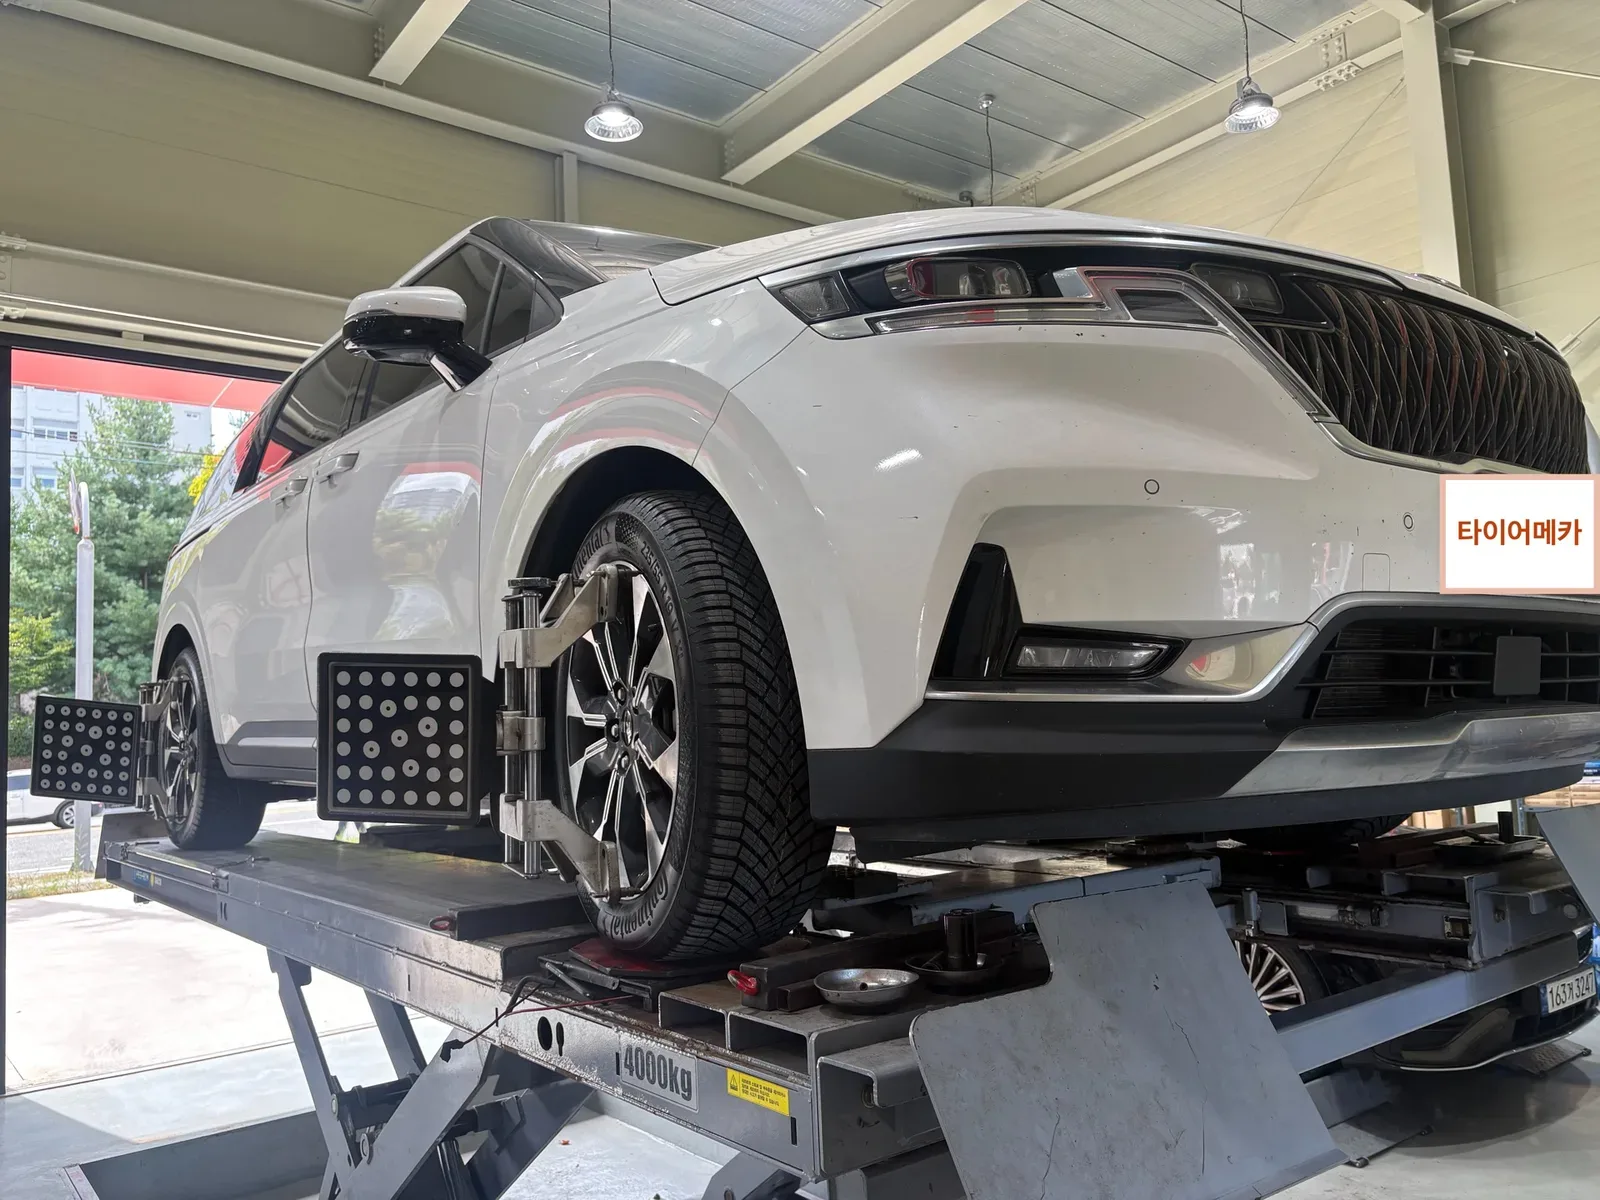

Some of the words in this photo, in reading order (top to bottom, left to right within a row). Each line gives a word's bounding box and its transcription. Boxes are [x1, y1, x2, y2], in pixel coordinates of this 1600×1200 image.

[610, 867, 668, 940] Continental
[1575, 972, 1594, 998] 3247
[623, 1045, 692, 1101] 4000kg
